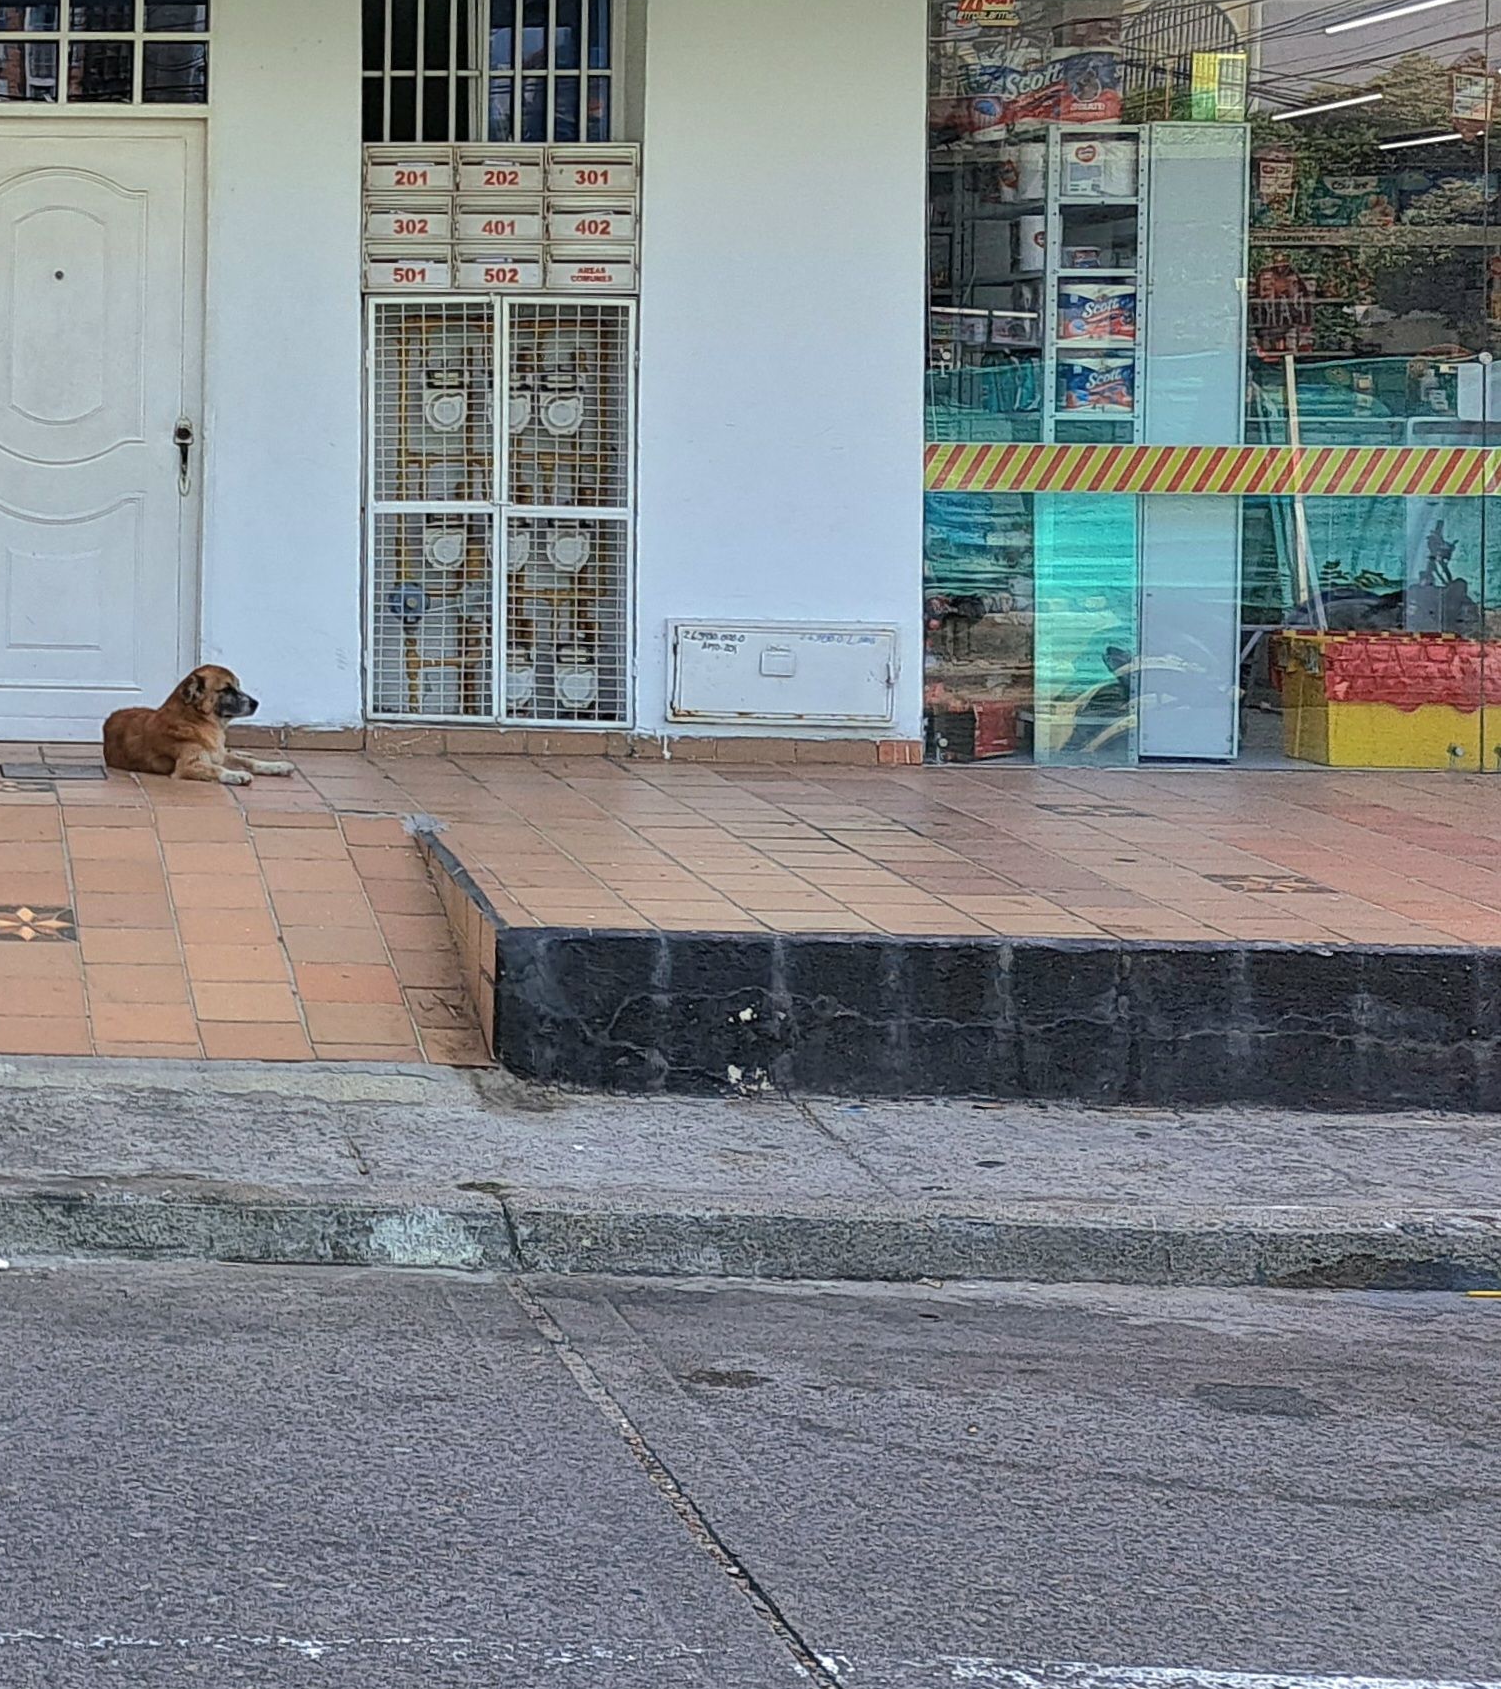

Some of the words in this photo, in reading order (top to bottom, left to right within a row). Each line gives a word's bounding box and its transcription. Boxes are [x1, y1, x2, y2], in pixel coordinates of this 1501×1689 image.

[1003, 62, 1065, 101] Scott
[394, 170, 428, 186] 201
[483, 170, 519, 186] 202
[574, 169, 610, 185] 301
[393, 219, 429, 234] 302
[481, 220, 516, 235] 401
[574, 219, 611, 235] 402
[392, 268, 427, 283] 501
[483, 268, 519, 283] 502
[1081, 297, 1120, 319] Scott
[1085, 368, 1124, 390] Scott
